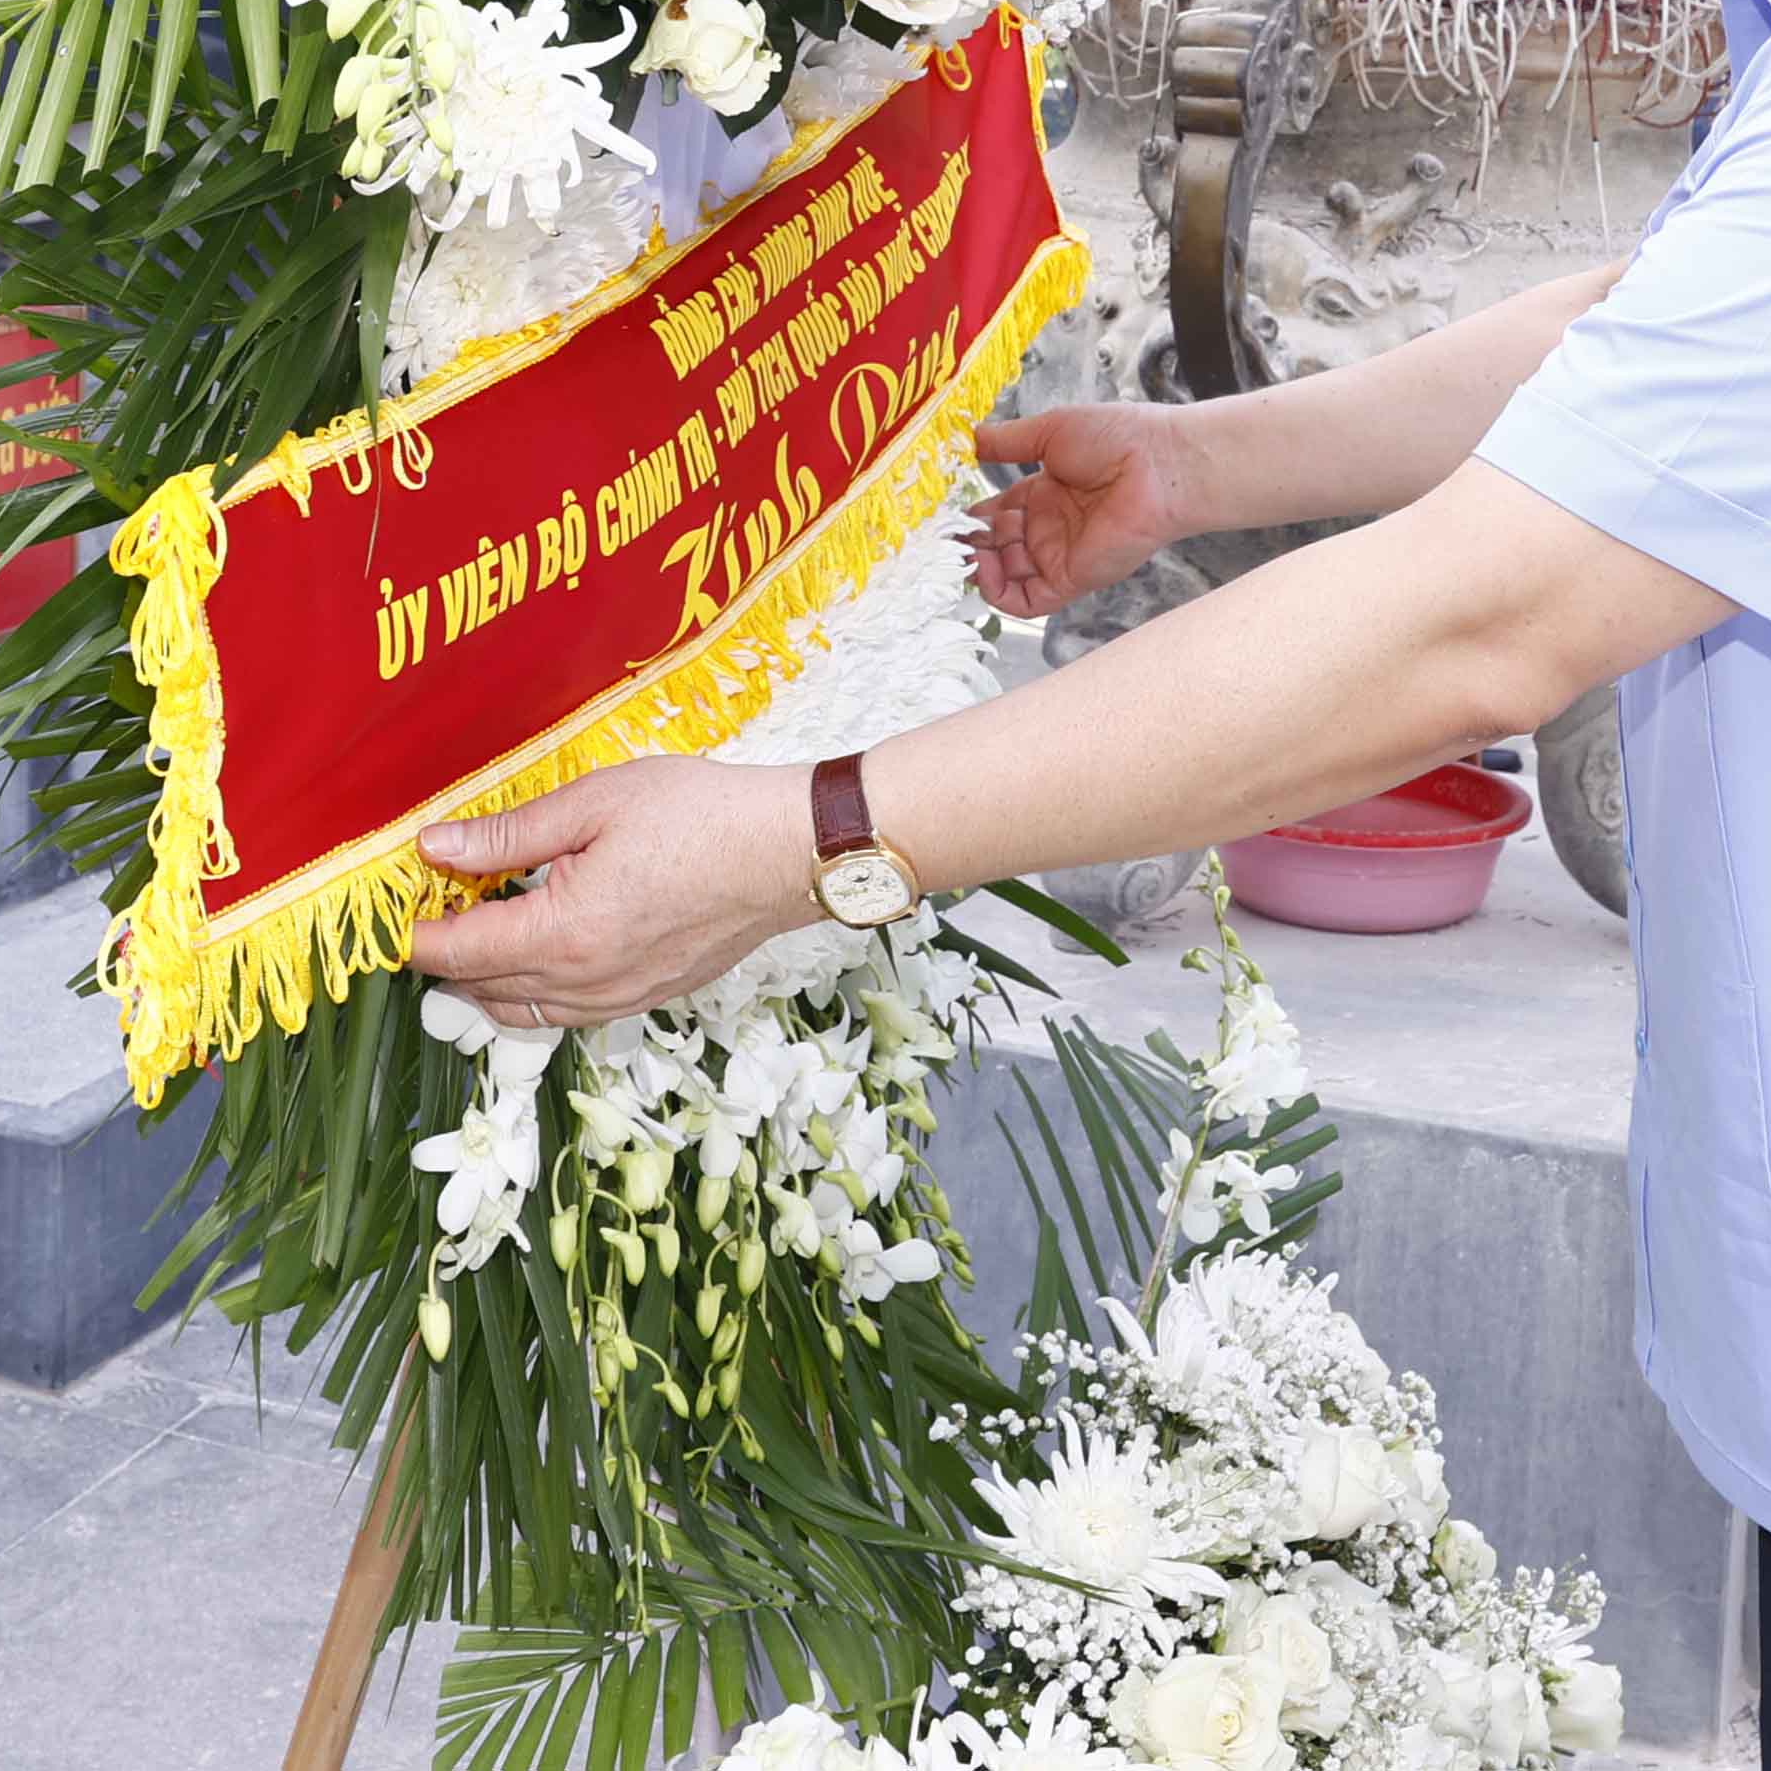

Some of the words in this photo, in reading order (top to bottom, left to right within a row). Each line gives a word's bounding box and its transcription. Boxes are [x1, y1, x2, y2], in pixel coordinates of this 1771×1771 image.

[649, 292, 725, 381] ĐỒNG
[748, 223, 814, 306] VƯƠNG
[805, 179, 854, 260] ĐÌNH
[844, 146, 903, 226] HUỆ
[376, 577, 428, 681] ỦY
[437, 534, 529, 646] VIÊN
[535, 488, 589, 592] BỘ
[595, 448, 683, 557] CHÍNH
[677, 408, 721, 493] TRỊ
[715, 346, 756, 449] CHỦ
[746, 330, 801, 422] TỊCH
[786, 278, 851, 381] QUỐC
[837, 259, 884, 335] HỘI
[873, 217, 926, 307] NƯỚC
[624, 431, 823, 669] Kính
